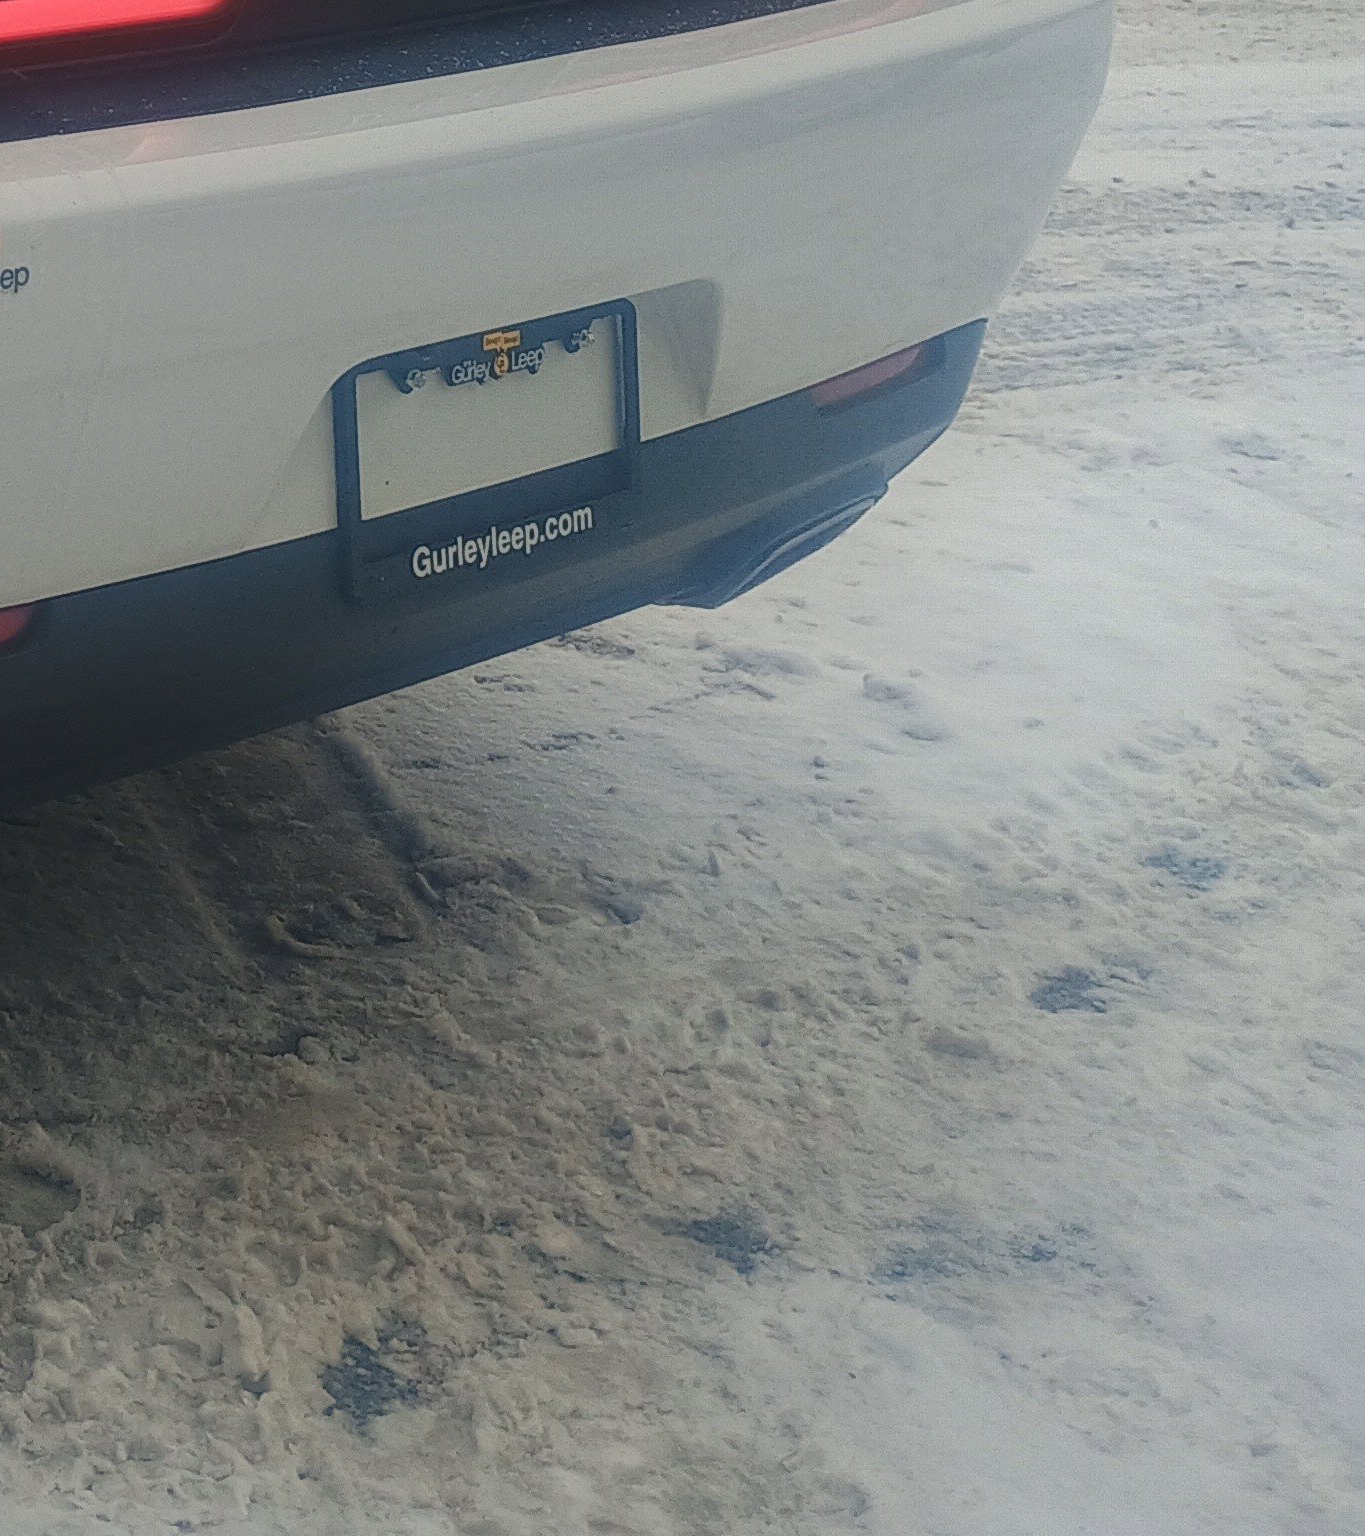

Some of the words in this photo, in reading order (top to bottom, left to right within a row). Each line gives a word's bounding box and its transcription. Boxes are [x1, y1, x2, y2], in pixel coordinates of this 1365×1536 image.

[451, 359, 491, 383] Gurley
[511, 348, 545, 371] Leep
[412, 506, 593, 578] Gurleyleep.com
